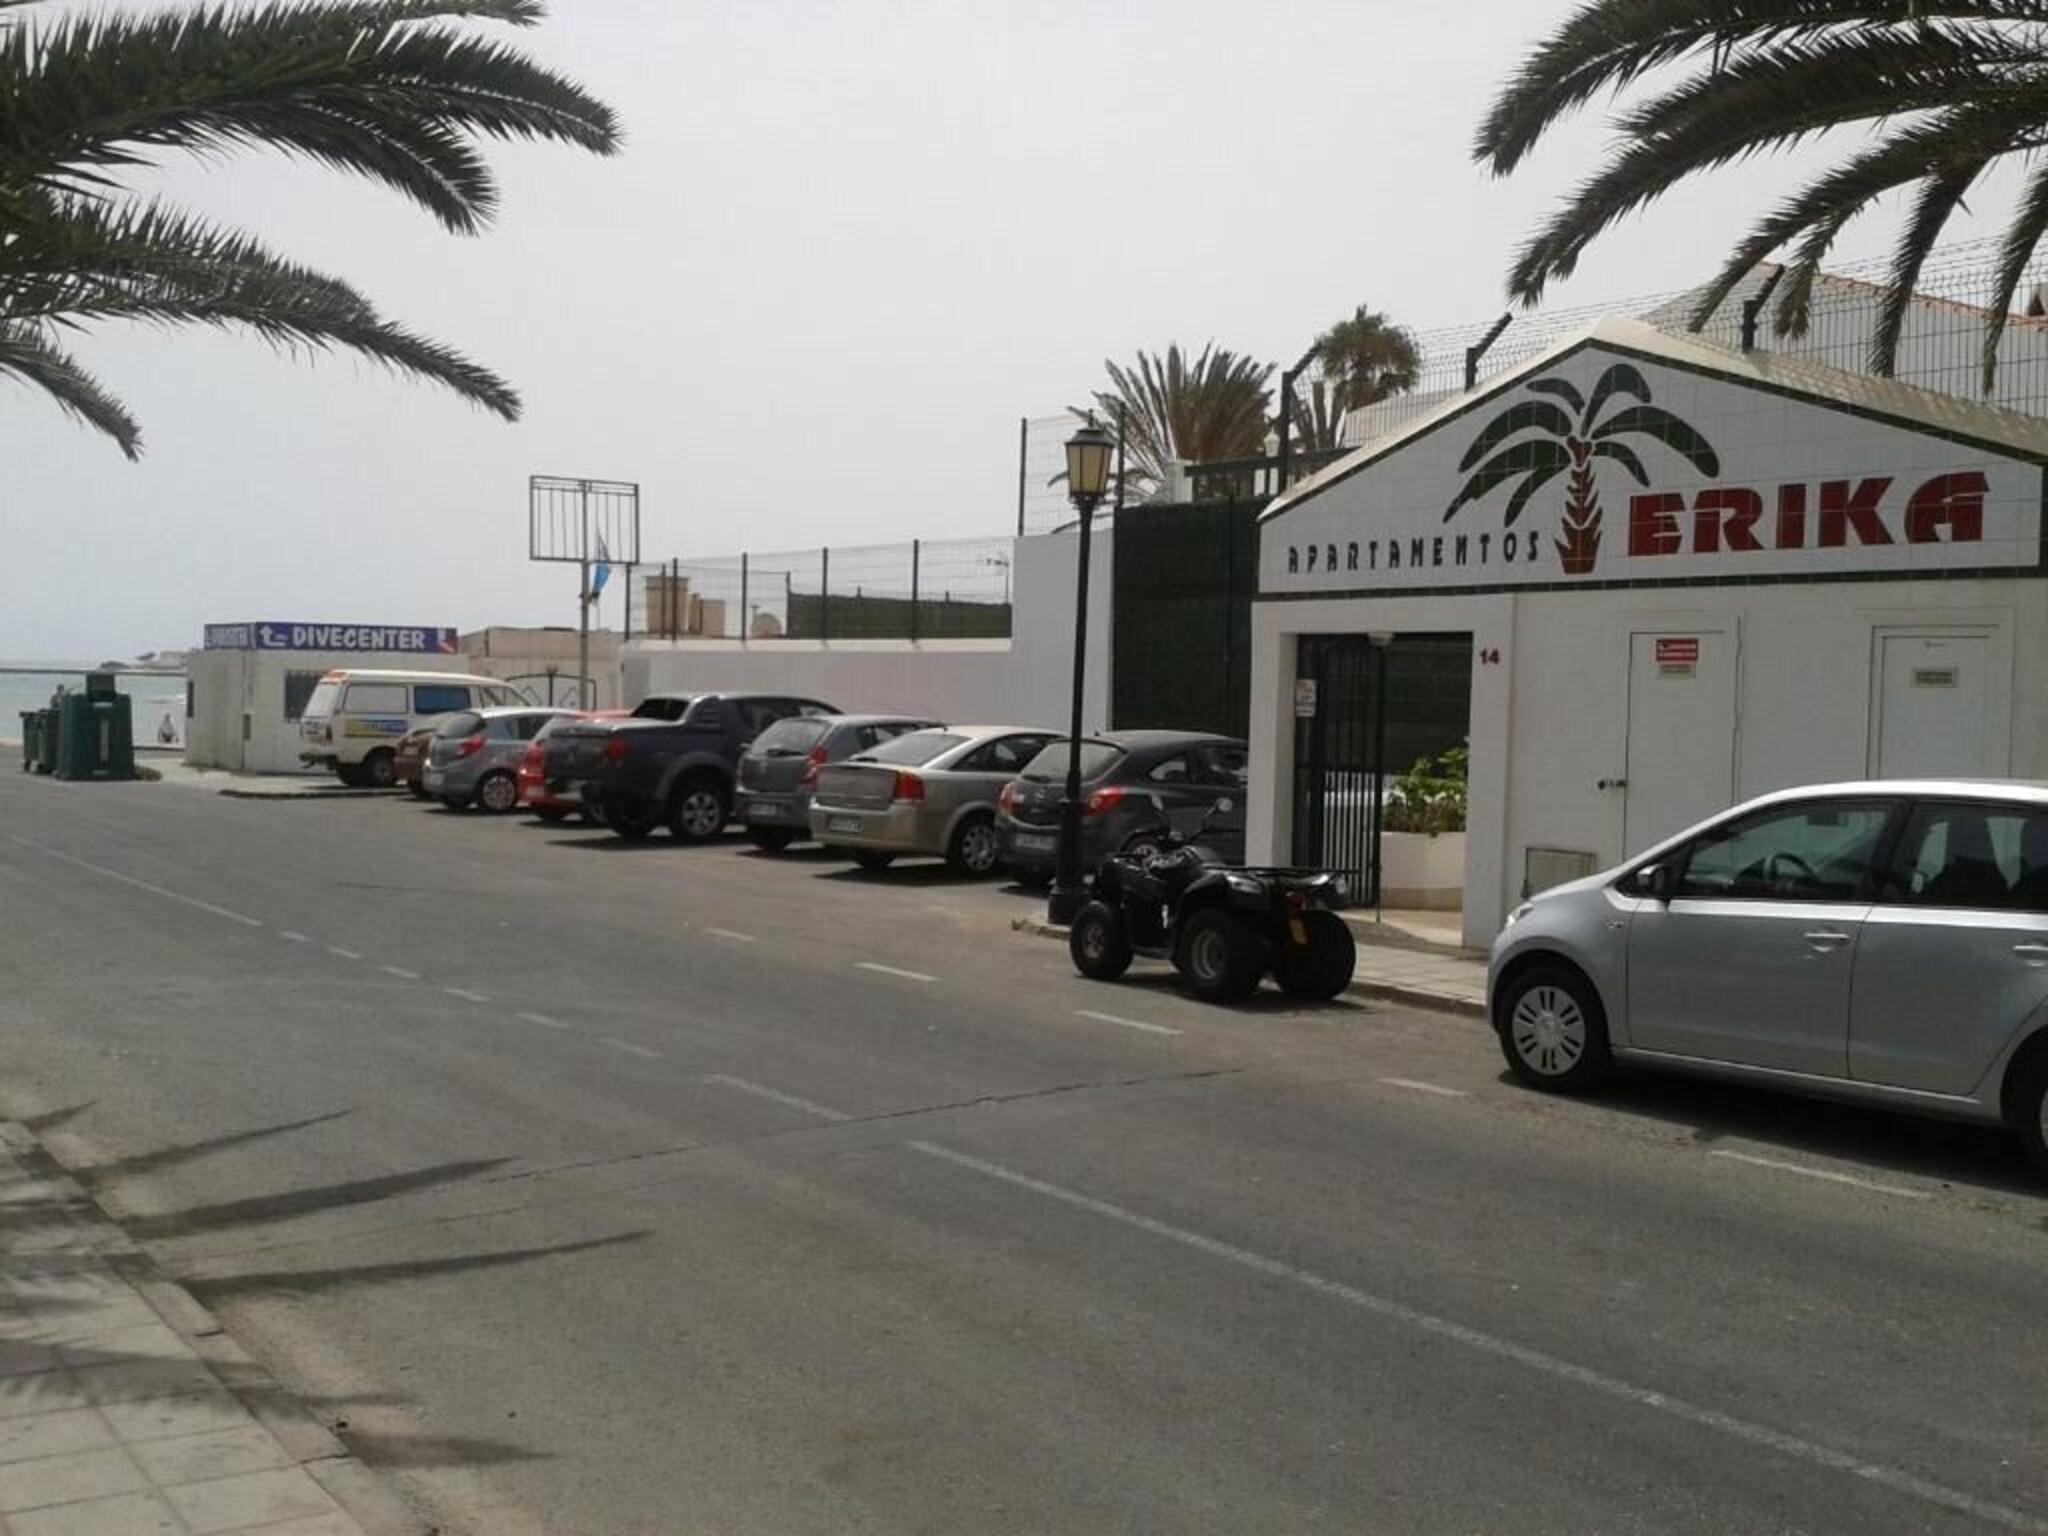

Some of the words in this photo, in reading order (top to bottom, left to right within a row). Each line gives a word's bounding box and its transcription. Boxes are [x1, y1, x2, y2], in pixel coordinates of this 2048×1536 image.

[1628, 472, 1989, 556] ERIKA
[1288, 530, 1539, 574] APARTAMENTOS
[292, 626, 425, 649] DIVECENTER
[1480, 648, 1500, 665] 14
